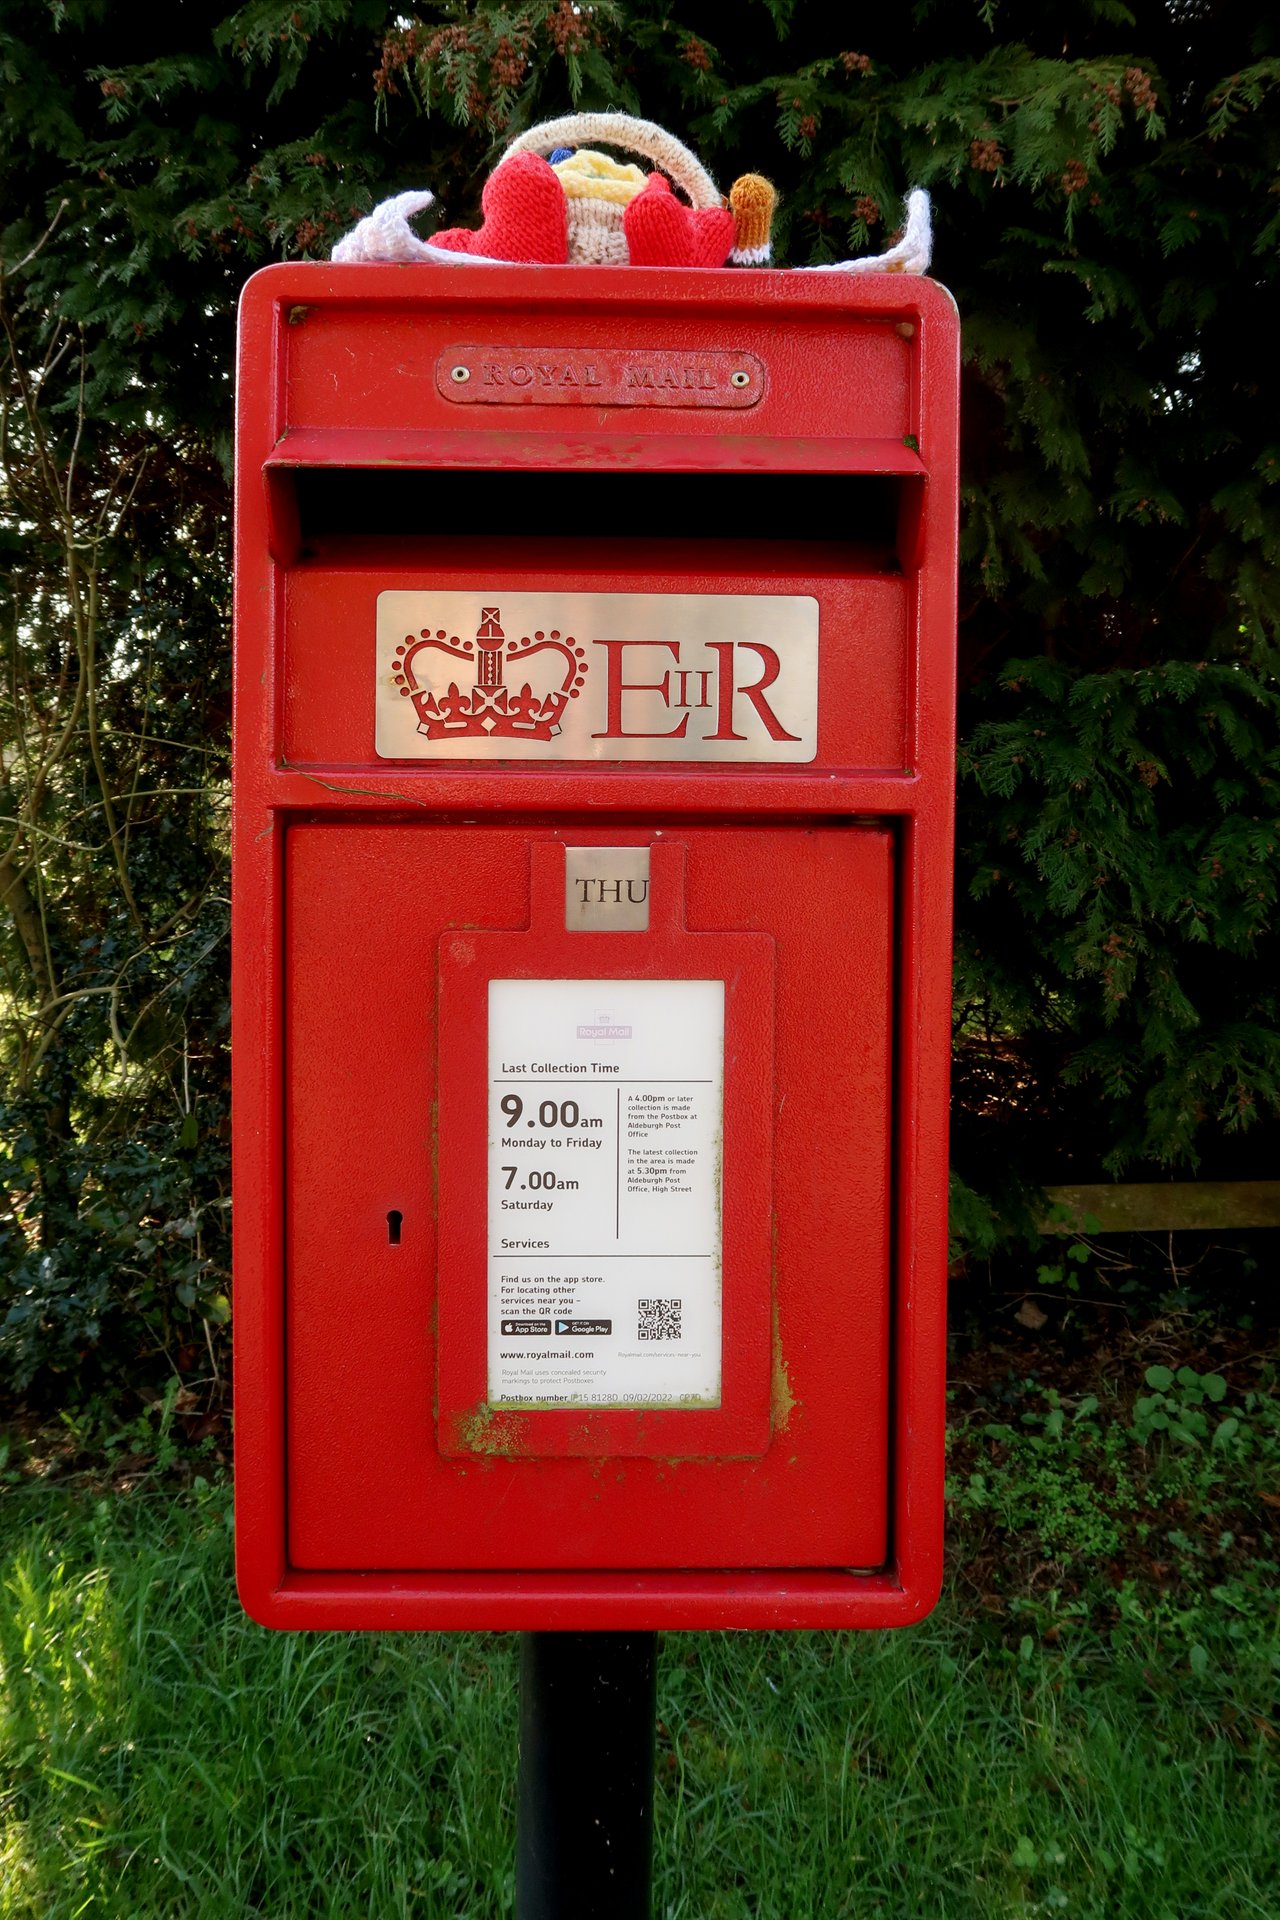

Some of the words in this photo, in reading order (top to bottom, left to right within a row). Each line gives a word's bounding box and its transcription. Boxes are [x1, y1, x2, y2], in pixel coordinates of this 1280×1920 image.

[483, 363, 602, 387] ROYAL
[627, 366, 718, 390] MAIL
[575, 878, 650, 904] THU
[580, 1027, 606, 1038] Royal
[608, 1027, 629, 1036] Mail
[502, 1063, 527, 1073] Last
[530, 1063, 587, 1073] Collection
[591, 1063, 620, 1073] Time
[635, 1095, 665, 1103] 4.00pm
[500, 1094, 603, 1128] 9.00am
[628, 1122, 663, 1130] Aldeburgh
[501, 1137, 547, 1149] Monday
[551, 1138, 562, 1147] to
[566, 1137, 602, 1149] Friday
[637, 1167, 667, 1176] 5.30pm
[501, 1166, 579, 1190] 7.00am
[652, 1186, 669, 1194] High
[501, 1200, 554, 1211] Saturday
[501, 1238, 550, 1248] Services
[501, 1275, 519, 1283] Find
[547, 1275, 561, 1283] the
[563, 1277, 579, 1285] app
[501, 1286, 514, 1294] For
[517, 1286, 550, 1295] locating
[553, 1286, 576, 1294] other
[501, 1297, 535, 1305] services
[559, 1298, 574, 1306] you
[539, 1307, 551, 1316] QR
[572, 1326, 594, 1334] Google
[595, 1326, 609, 1334] Play
[500, 1350, 594, 1360] www.royalmail.com
[501, 1394, 533, 1402] Postbox
[623, 1393, 673, 1402] 09/02/2022
